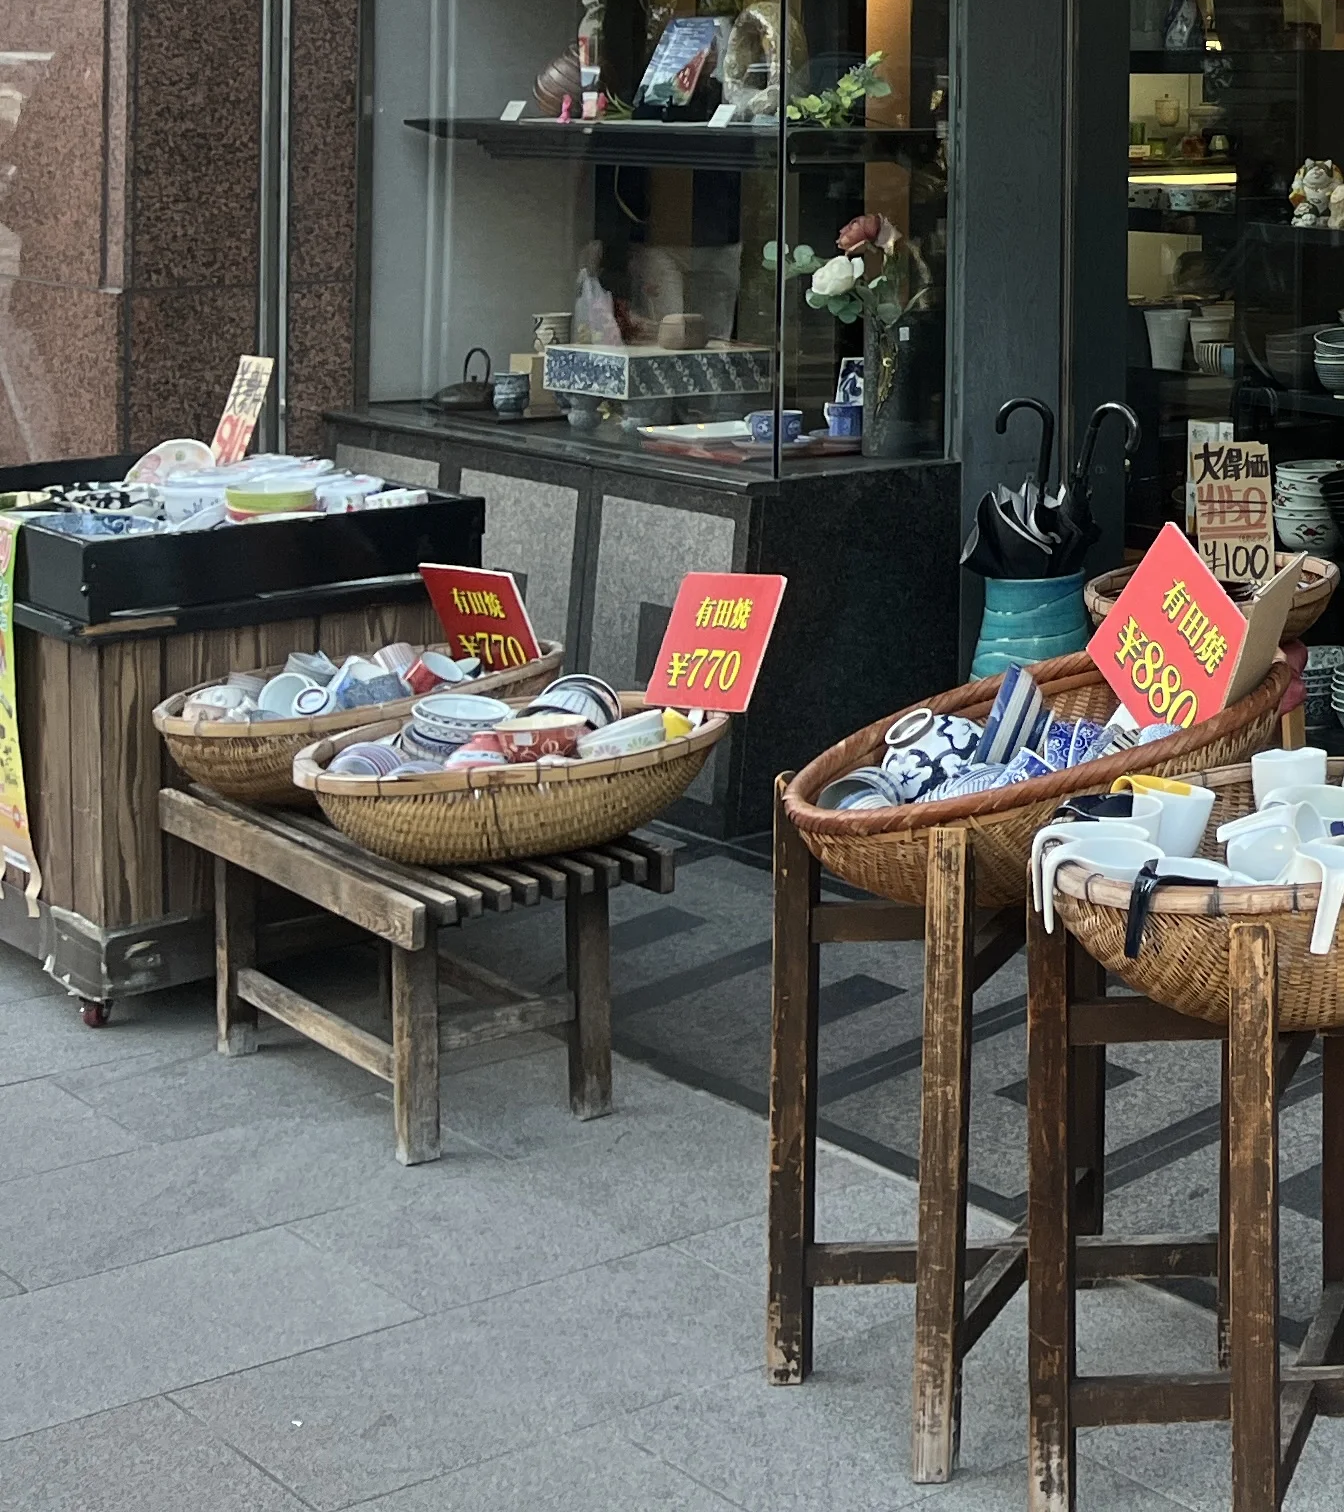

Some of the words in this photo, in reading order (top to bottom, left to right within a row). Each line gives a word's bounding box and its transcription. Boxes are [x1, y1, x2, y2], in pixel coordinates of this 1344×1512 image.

[1204, 541, 1269, 579] ¥100
[450, 587, 506, 619] 有田焼
[695, 596, 753, 629] 有田焼
[1162, 577, 1228, 675] 有田焼
[458, 632, 527, 666] ¥770
[667, 648, 741, 691] ¥770
[1114, 615, 1198, 728] ¥880
